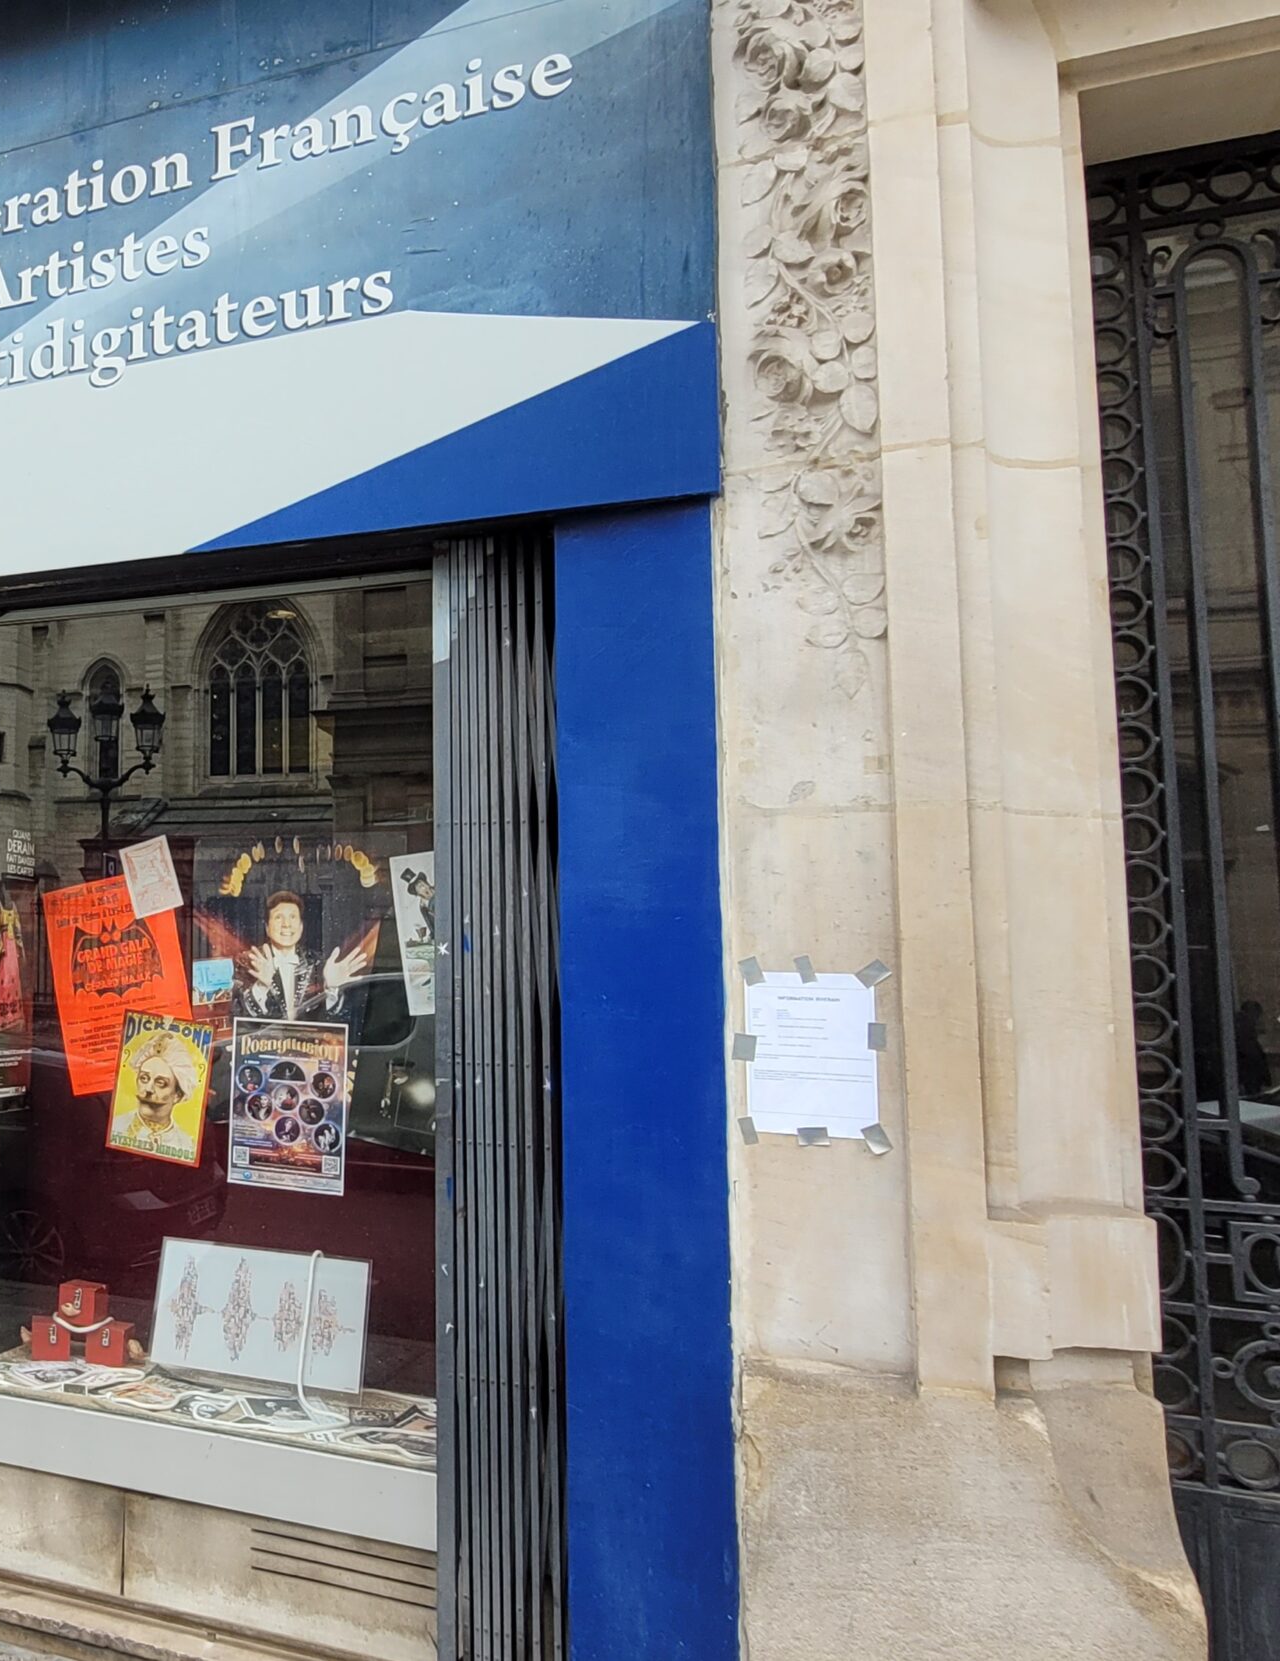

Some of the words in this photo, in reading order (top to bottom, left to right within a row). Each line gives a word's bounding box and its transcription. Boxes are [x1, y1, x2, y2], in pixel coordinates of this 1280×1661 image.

[210, 52, 574, 181] Française
[7, 838, 35, 856] DERAIN
[77, 944, 118, 963] GRAND
[120, 936, 151, 954] GALA
[87, 960, 103, 973] DE
[105, 952, 144, 970] MAGIE
